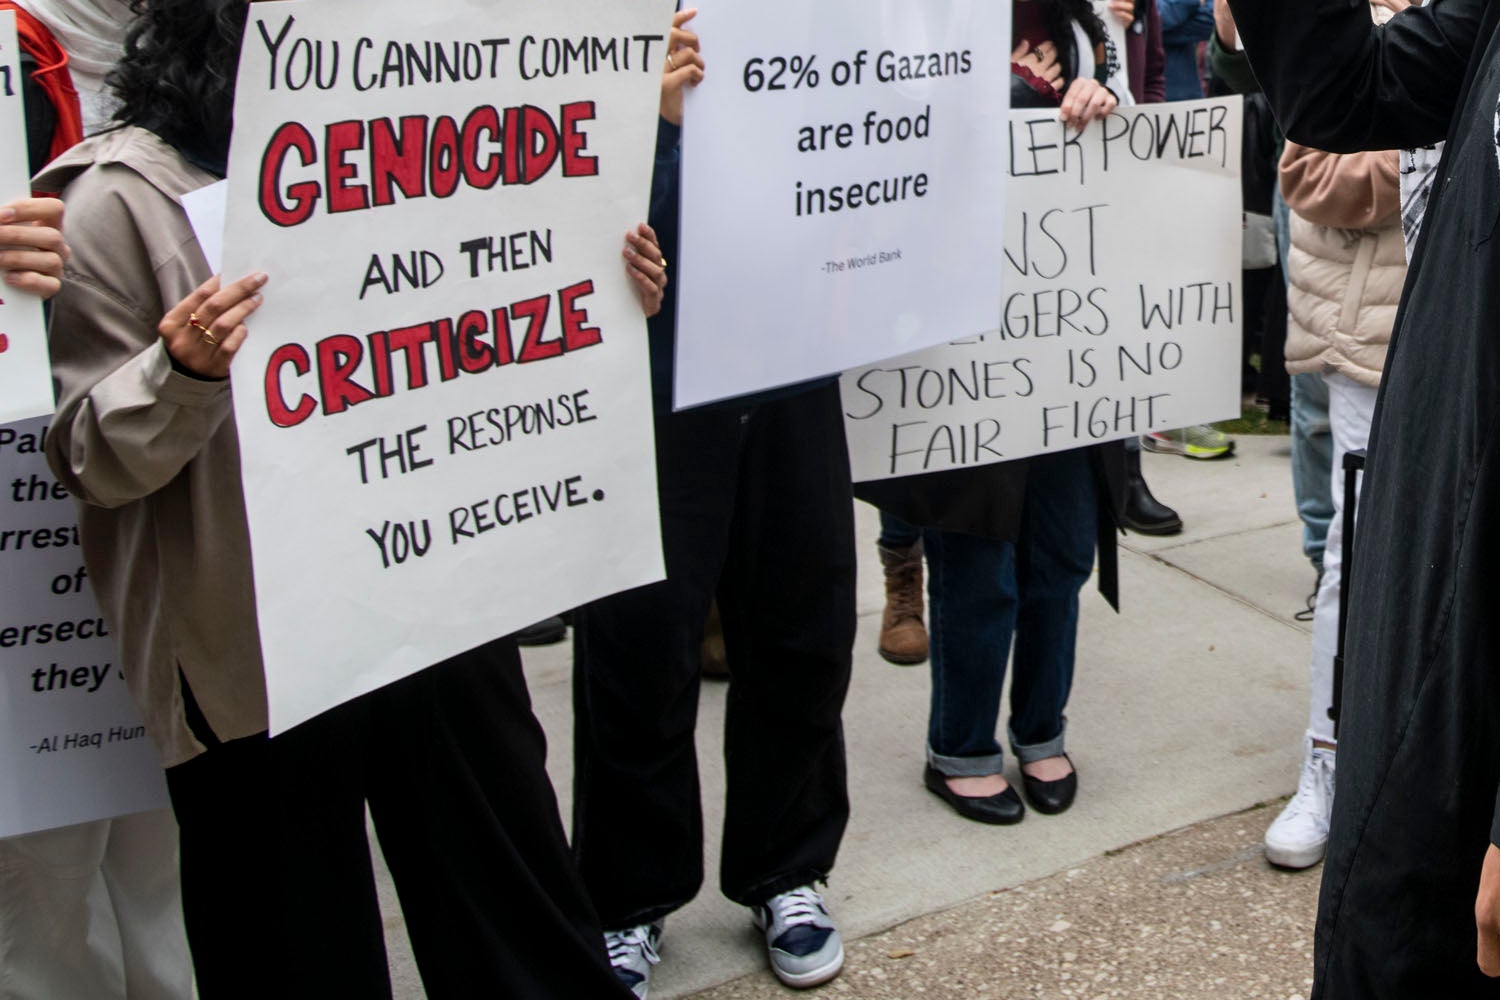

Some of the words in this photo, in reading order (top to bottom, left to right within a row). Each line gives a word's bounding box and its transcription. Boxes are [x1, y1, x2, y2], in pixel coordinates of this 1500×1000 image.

[256, 15, 340, 91] YOU
[352, 37, 511, 91] CANNOT
[518, 34, 665, 81] COMMIT
[742, 54, 820, 92] 62%
[831, 49, 868, 86] of
[875, 49, 973, 83] Gazans
[797, 122, 854, 153] are
[862, 104, 931, 146] food
[1101, 105, 1229, 173] POWER
[258, 99, 600, 228] GENOCIDE
[795, 172, 929, 217] insecure
[359, 250, 445, 300] AND
[459, 228, 553, 278] THEN
[847, 254, 877, 270] World
[879, 248, 903, 264] Bank
[1139, 281, 1234, 330] WITH
[264, 278, 604, 428] CRITICIZE
[845, 358, 1035, 420] STONES
[1067, 347, 1097, 388] IS
[1118, 341, 1183, 381] NO
[346, 425, 434, 484] THE
[447, 389, 597, 455] RESPONSE
[889, 418, 1004, 475] FAIR
[1043, 393, 1172, 447] FIGHT.
[365, 518, 432, 569] YOU
[448, 475, 606, 545] RECEIVE.
[51, 565, 88, 595] of
[31, 663, 112, 693] they
[63, 732, 103, 750] Haq
